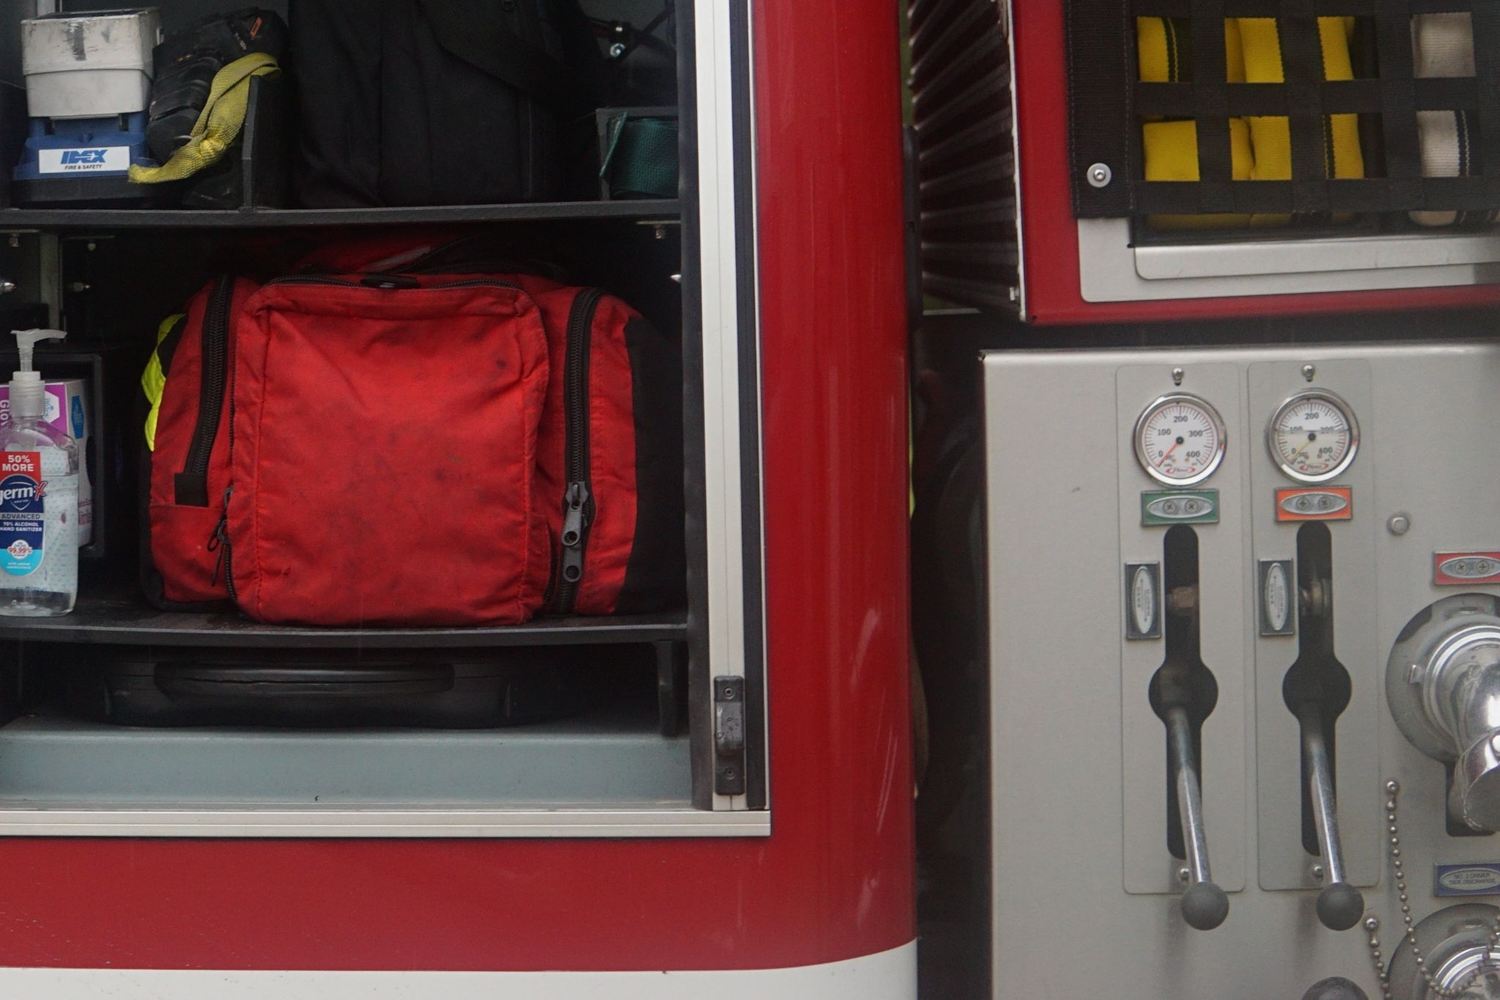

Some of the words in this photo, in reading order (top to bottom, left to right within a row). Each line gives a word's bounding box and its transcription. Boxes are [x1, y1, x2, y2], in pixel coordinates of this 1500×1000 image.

[60, 149, 108, 164] IDEX
[1305, 412, 1319, 420] 200
[1157, 428, 1171, 436] 100
[1158, 450, 1163, 458] 0
[1291, 447, 1297, 455] 0
[1318, 446, 1333, 454] 400
[8, 454, 31, 463] 50%
[2, 463, 34, 472] MORE
